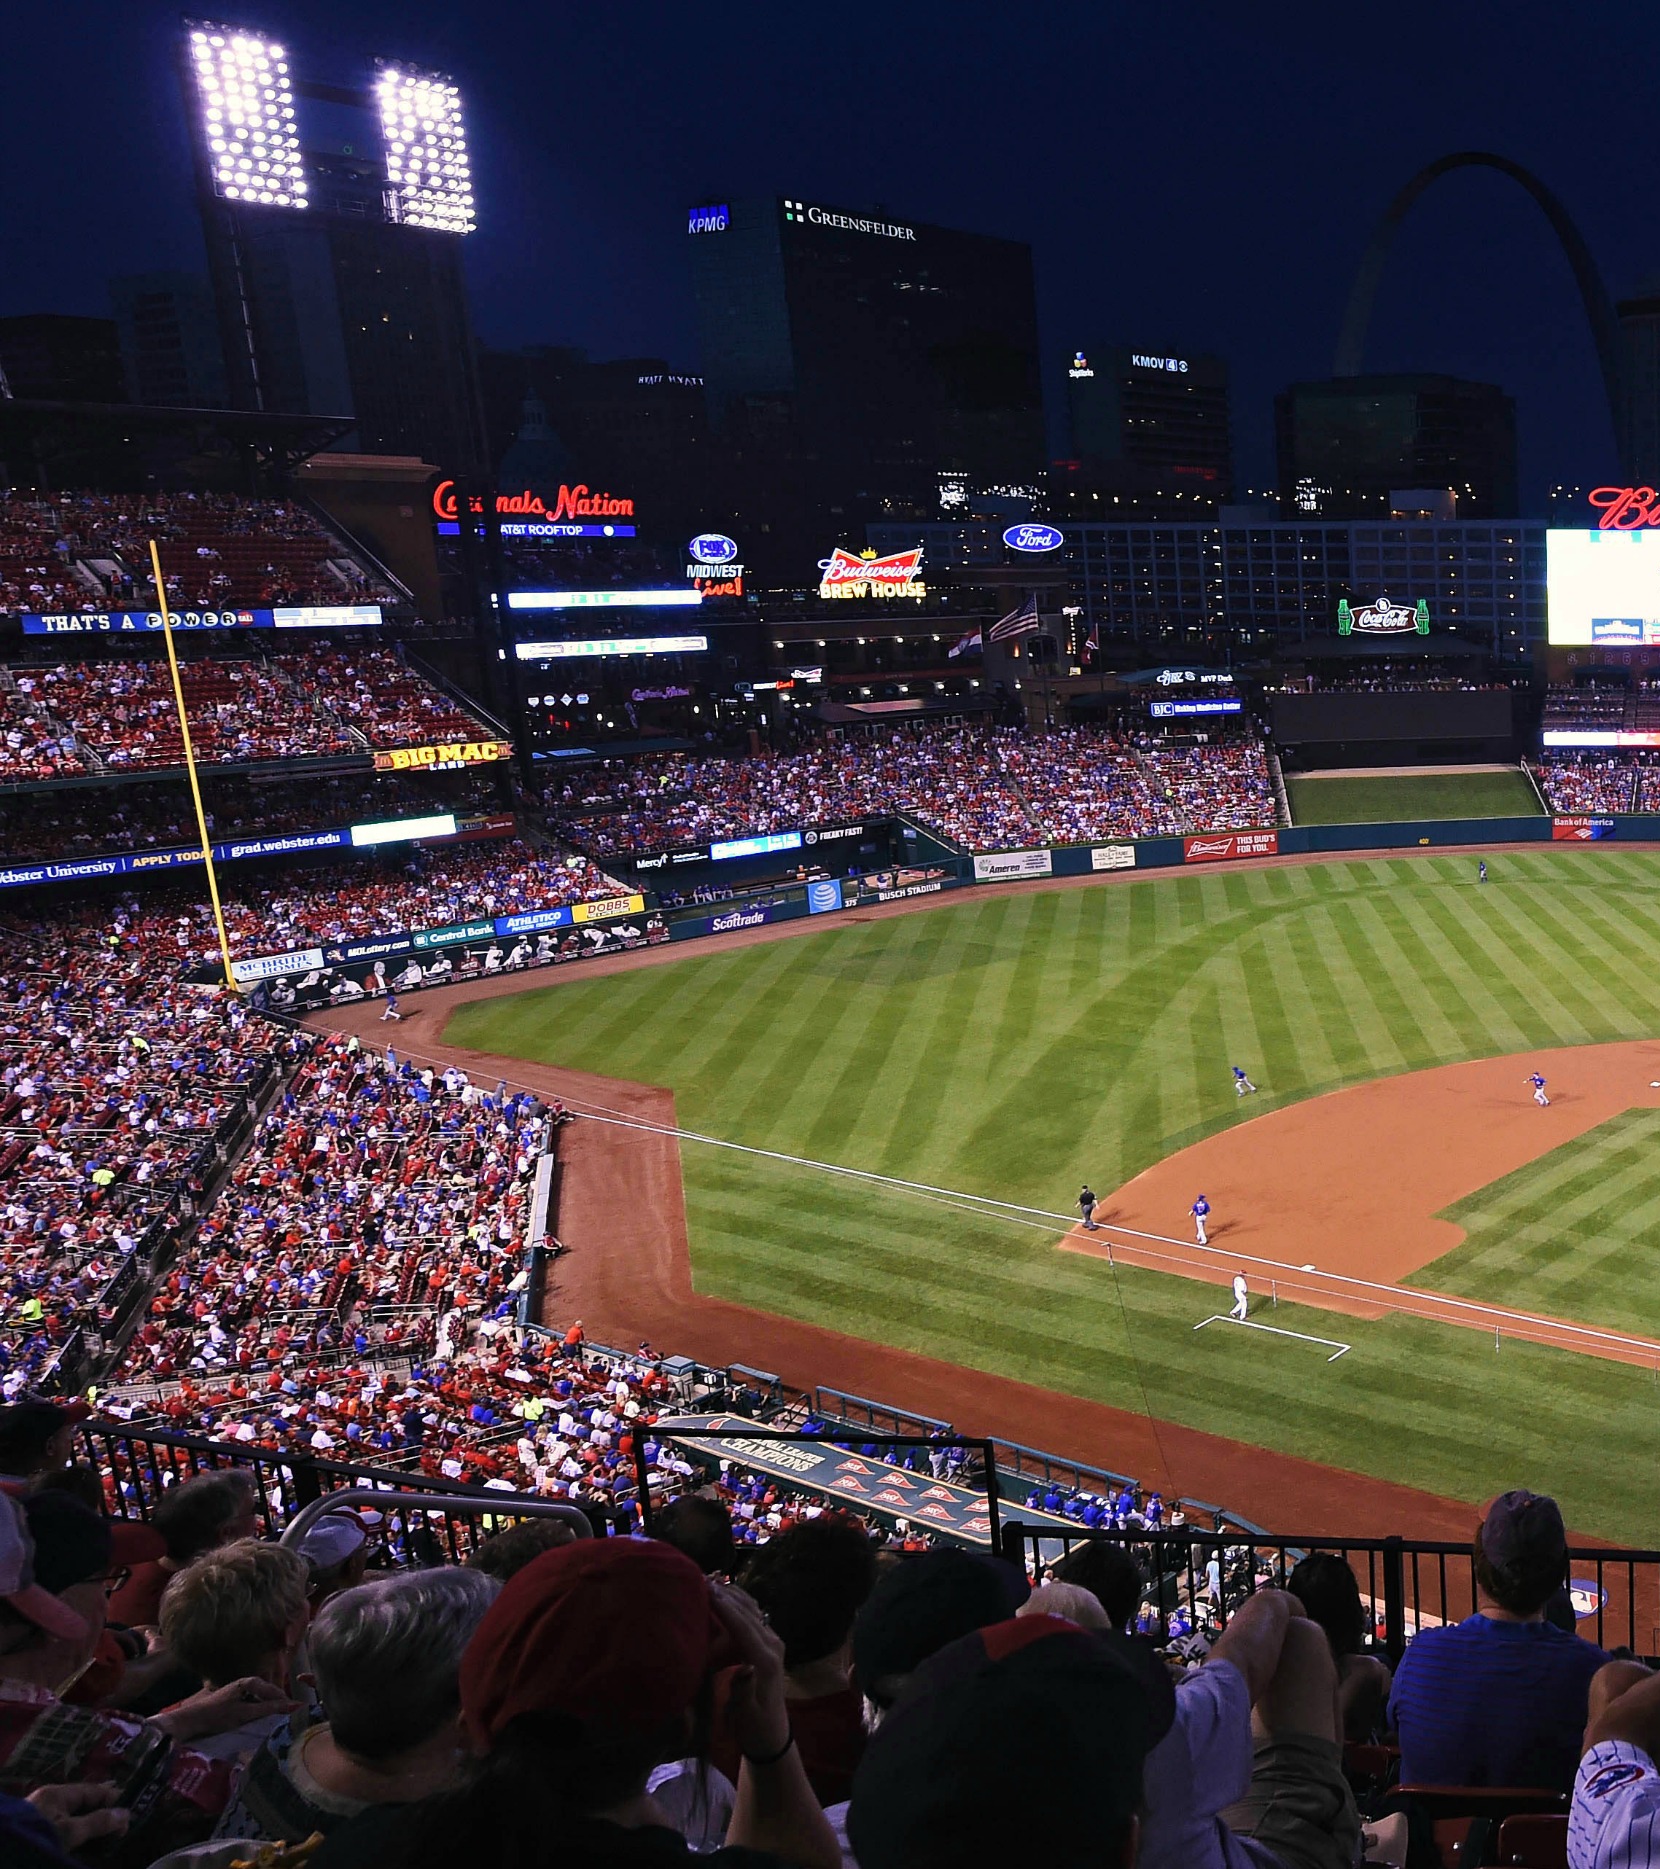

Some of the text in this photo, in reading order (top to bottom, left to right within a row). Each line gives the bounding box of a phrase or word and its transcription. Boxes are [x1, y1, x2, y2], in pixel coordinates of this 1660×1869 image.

[688, 215, 726, 234] KPMG
[807, 206, 917, 241] GREENSFELDER
[1132, 354, 1164, 369] KMOV
[668, 375, 704, 387] HYATT
[545, 484, 634, 522] Nation
[529, 525, 583, 536] ROOFTOP
[1016, 527, 1053, 547] Ford
[686, 564, 744, 578] MIDWEST
[817, 558, 923, 581] Budweiser
[820, 581, 926, 599] BREW HOUSE
[41, 614, 111, 633] THAT'S
[121, 614, 136, 631] A
[1153, 704, 1172, 715] BJC
[389, 742, 499, 770] BIG MAC
[428, 760, 466, 771] LAND
[1554, 818, 1614, 826] Bank of America
[230, 833, 341, 857] grad.webster.edu
[1236, 834, 1276, 845] THIS BUD'S
[131, 849, 215, 868] APPLY TODAY
[1236, 845, 1251, 854] FOR
[45, 860, 116, 878] University
[636, 855, 664, 869] Mercy
[988, 864, 1021, 874] Ameren
[878, 882, 942, 902] BUSCH STADIUM
[587, 898, 630, 914] DOBBS
[506, 911, 562, 928] ATHLETICO
[712, 910, 764, 932] Scottrade
[429, 923, 494, 943] Central Bank
[263, 960, 314, 976] HOMES
[720, 1438, 815, 1472] CHAMPIONS
